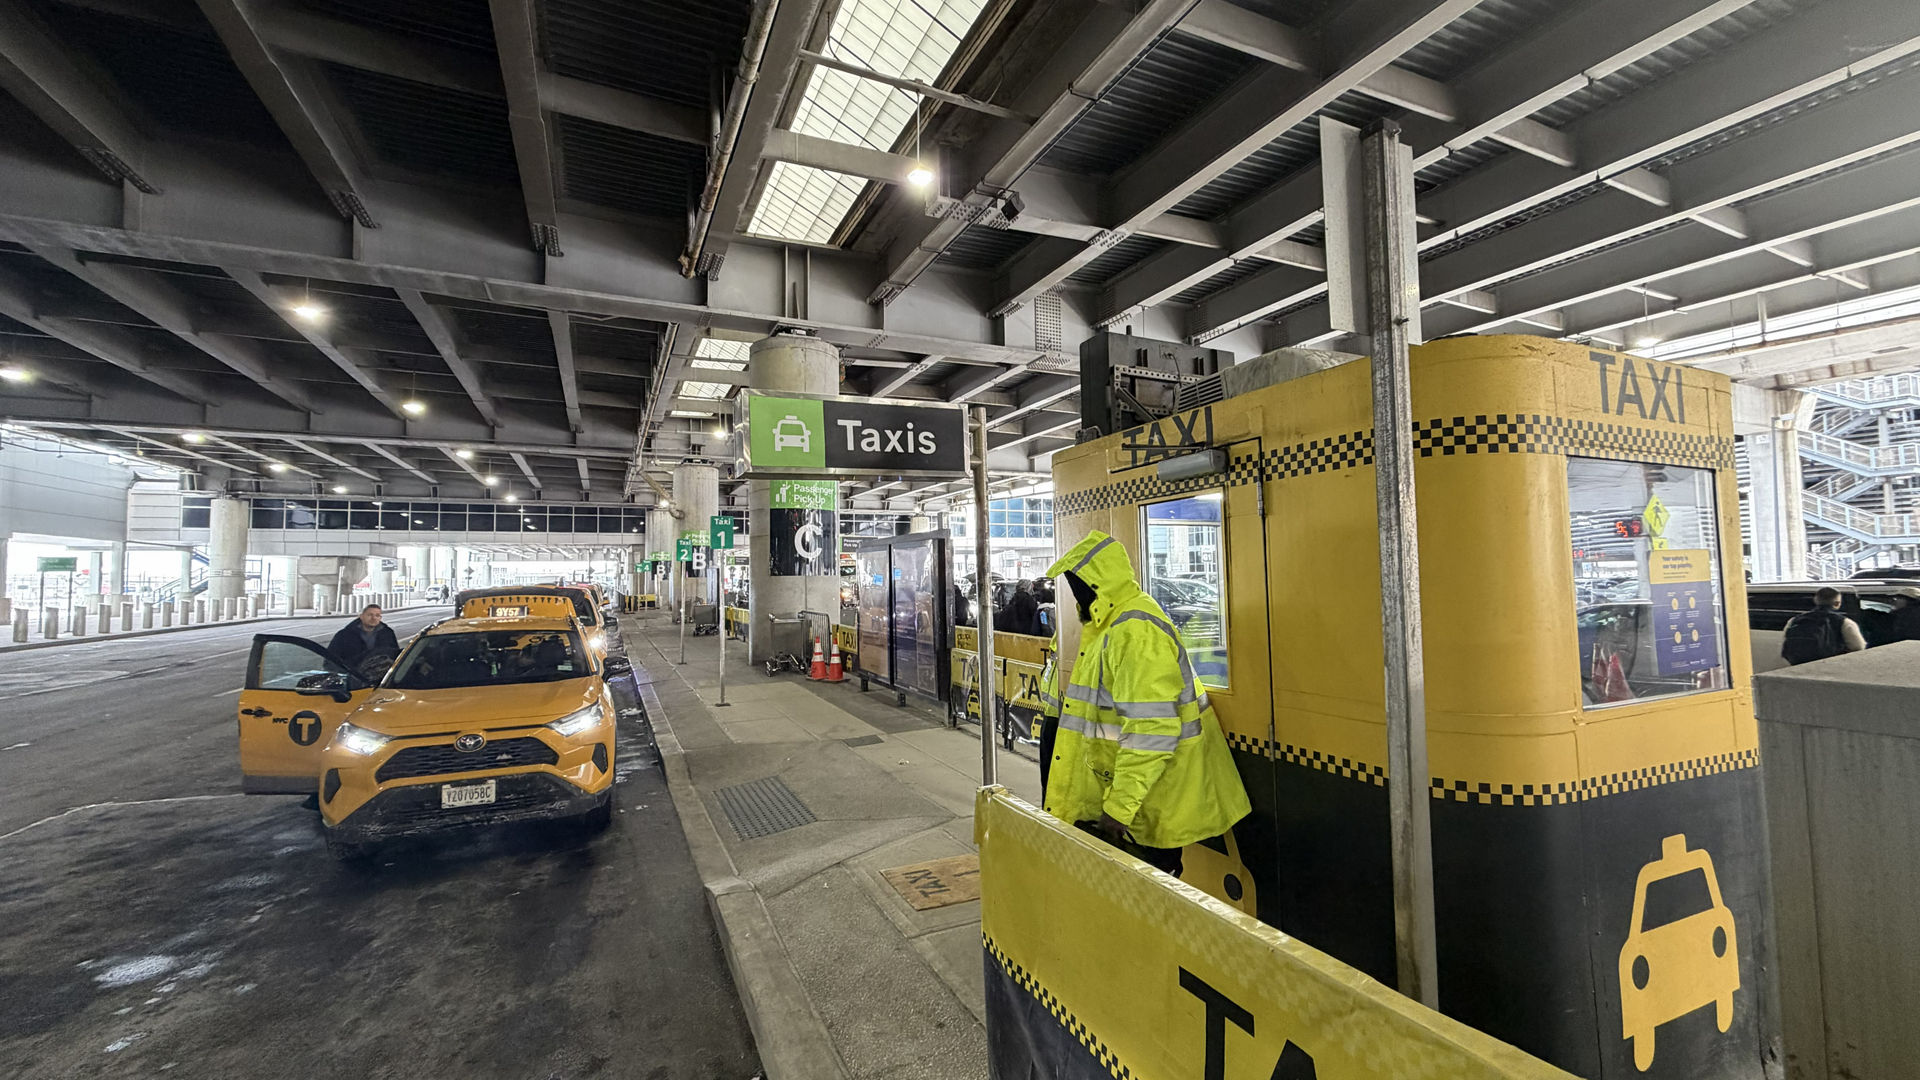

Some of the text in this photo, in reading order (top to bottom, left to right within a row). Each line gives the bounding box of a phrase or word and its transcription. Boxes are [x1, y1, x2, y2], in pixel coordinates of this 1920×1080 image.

[1589, 351, 1685, 424] TAXI
[837, 419, 937, 455] Taxis
[1122, 405, 1214, 467] TAXI
[793, 483, 834, 496] Passenger
[716, 531, 726, 547] 1
[794, 524, 823, 559] C
[680, 549, 689, 560] 2
[692, 552, 707, 570] B
[656, 564, 666, 577] B
[495, 607, 520, 616] 9Y57
[843, 631, 857, 649] TAXI
[296, 717, 316, 742] T
[446, 786, 491, 803] Y207058C
[901, 869, 951, 898] TAXI
